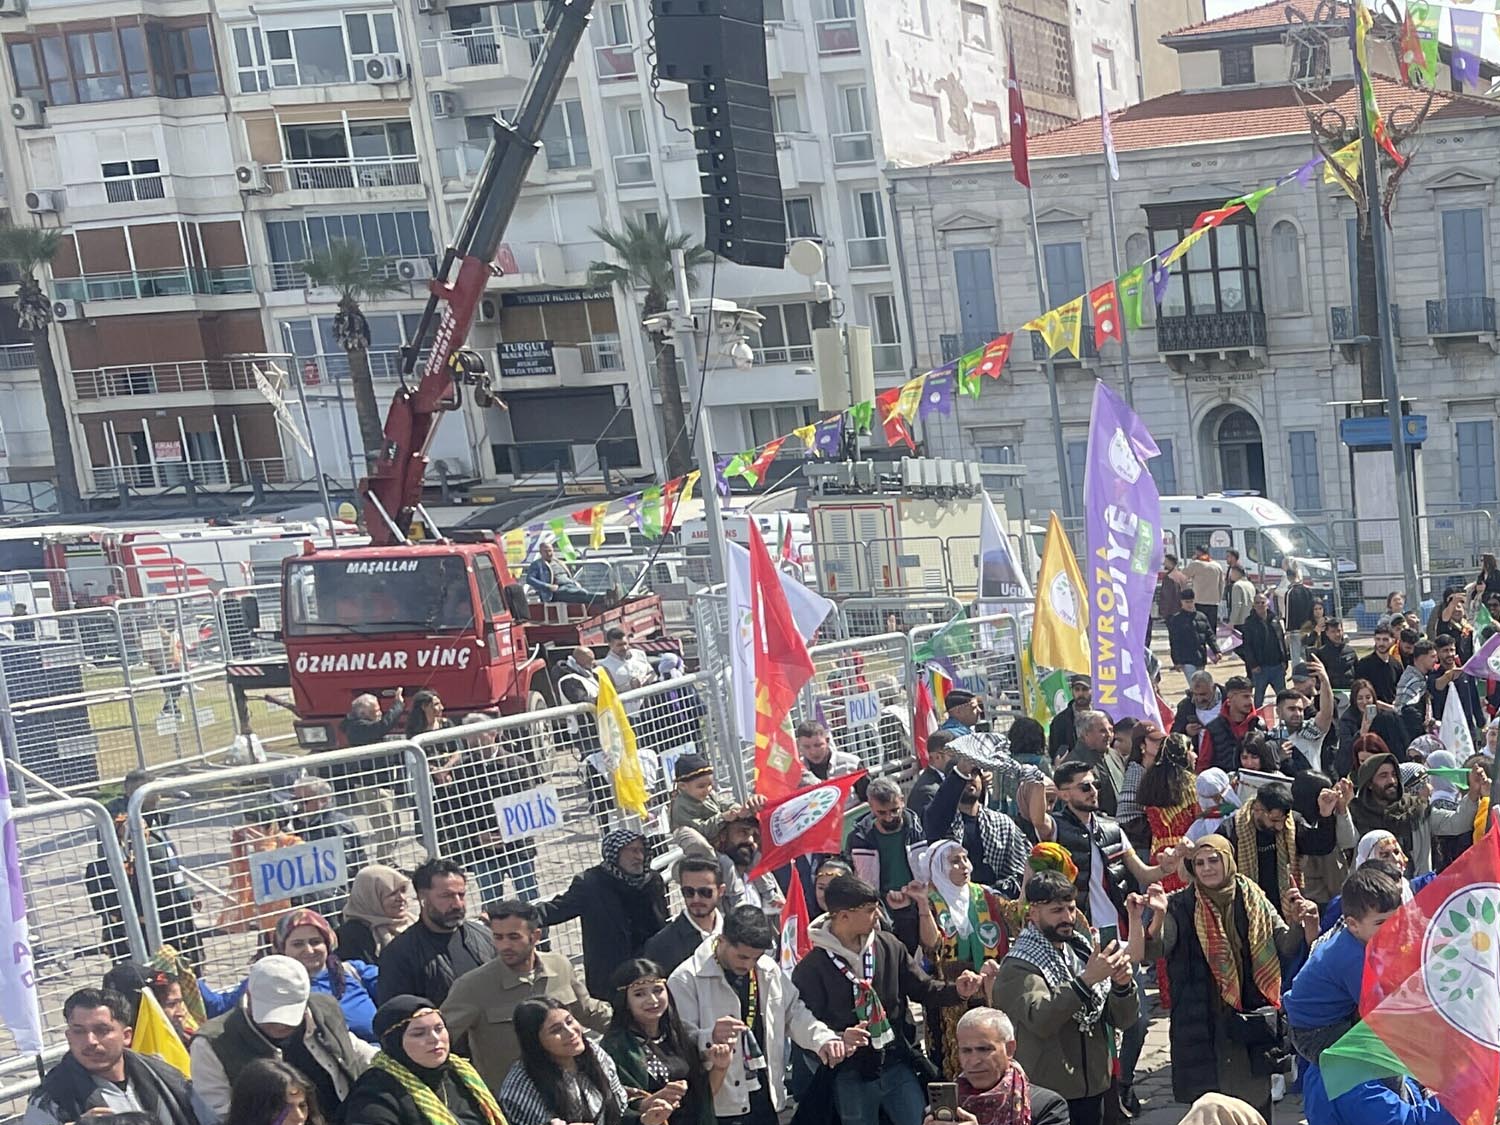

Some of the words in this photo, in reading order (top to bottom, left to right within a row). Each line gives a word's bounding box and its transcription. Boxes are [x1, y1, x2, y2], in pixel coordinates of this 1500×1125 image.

[503, 342, 546, 352] TURGUT
[346, 560, 418, 575] MAŞALLAH
[296, 651, 408, 673] ÖZHANLAR
[416, 645, 471, 670] VİNÇ
[850, 695, 878, 722] POLİS
[502, 793, 557, 837] POLİS
[260, 847, 336, 897] POLİS
